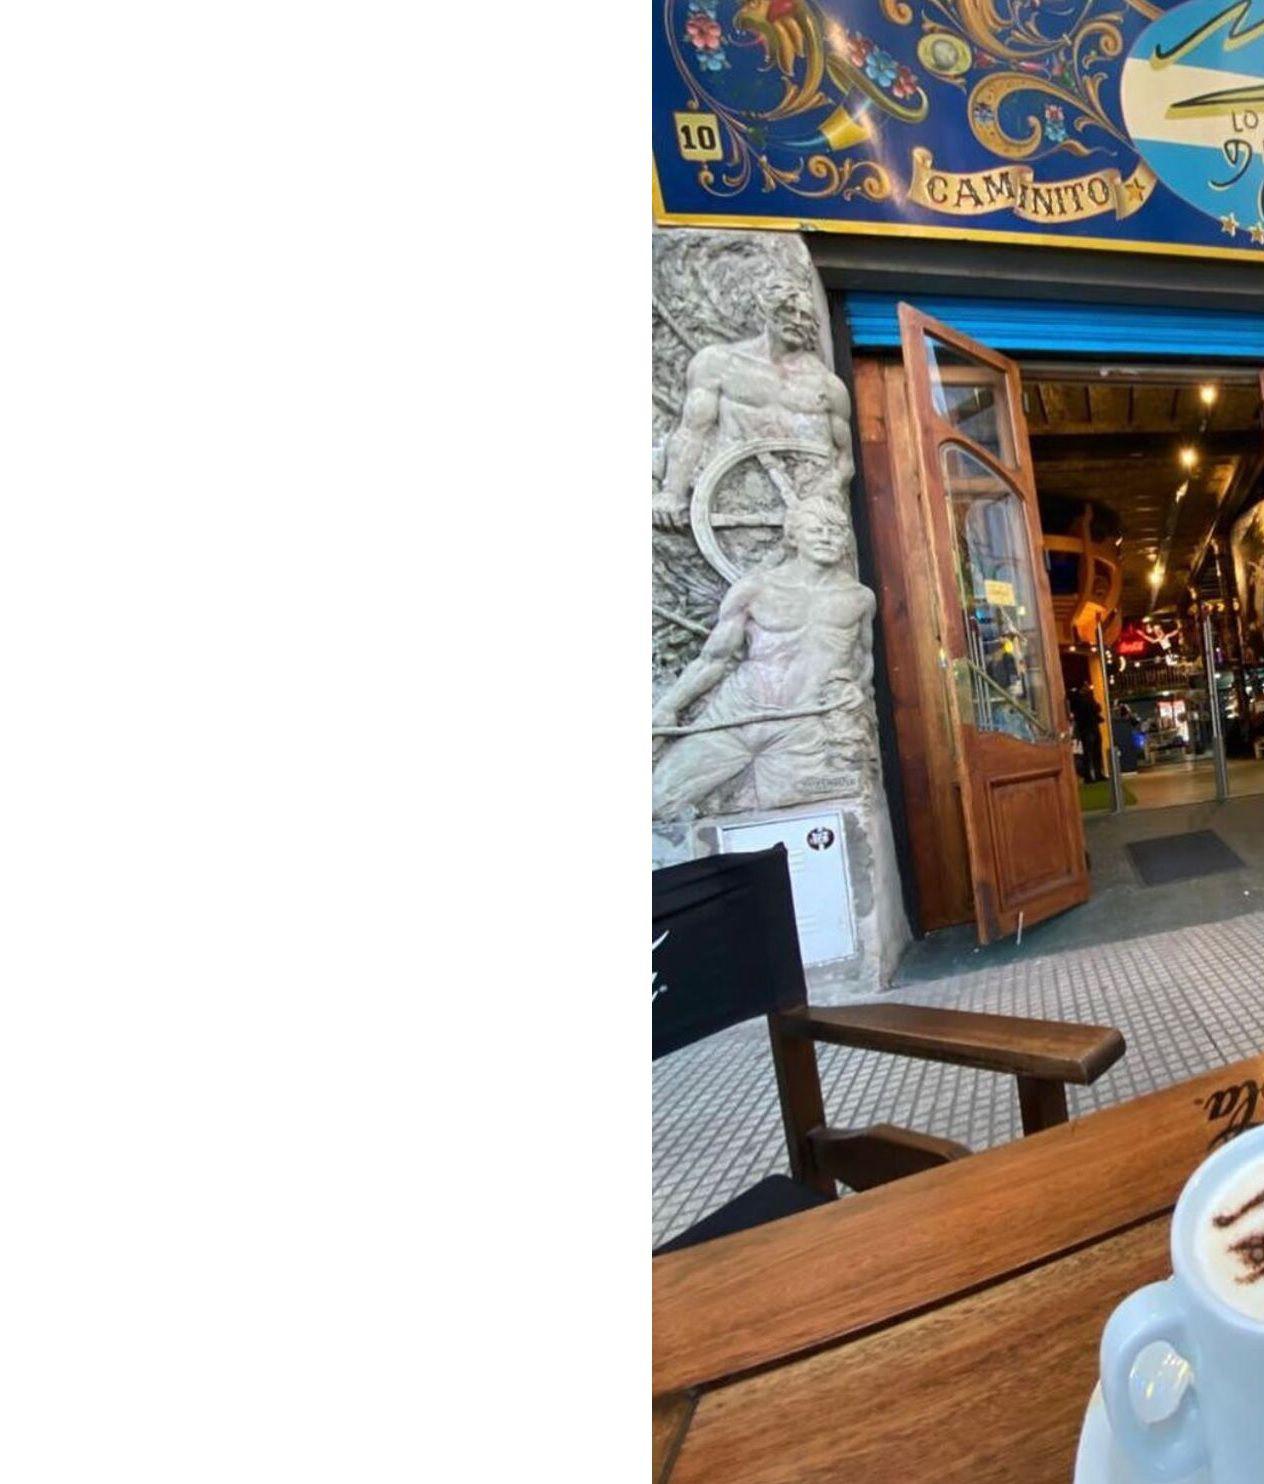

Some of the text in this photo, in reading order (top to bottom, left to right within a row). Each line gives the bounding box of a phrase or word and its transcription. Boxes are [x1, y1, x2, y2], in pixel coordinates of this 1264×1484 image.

[1230, 109, 1260, 134] LO
[680, 124, 717, 151] 10
[926, 171, 1110, 216] CAMINITO
